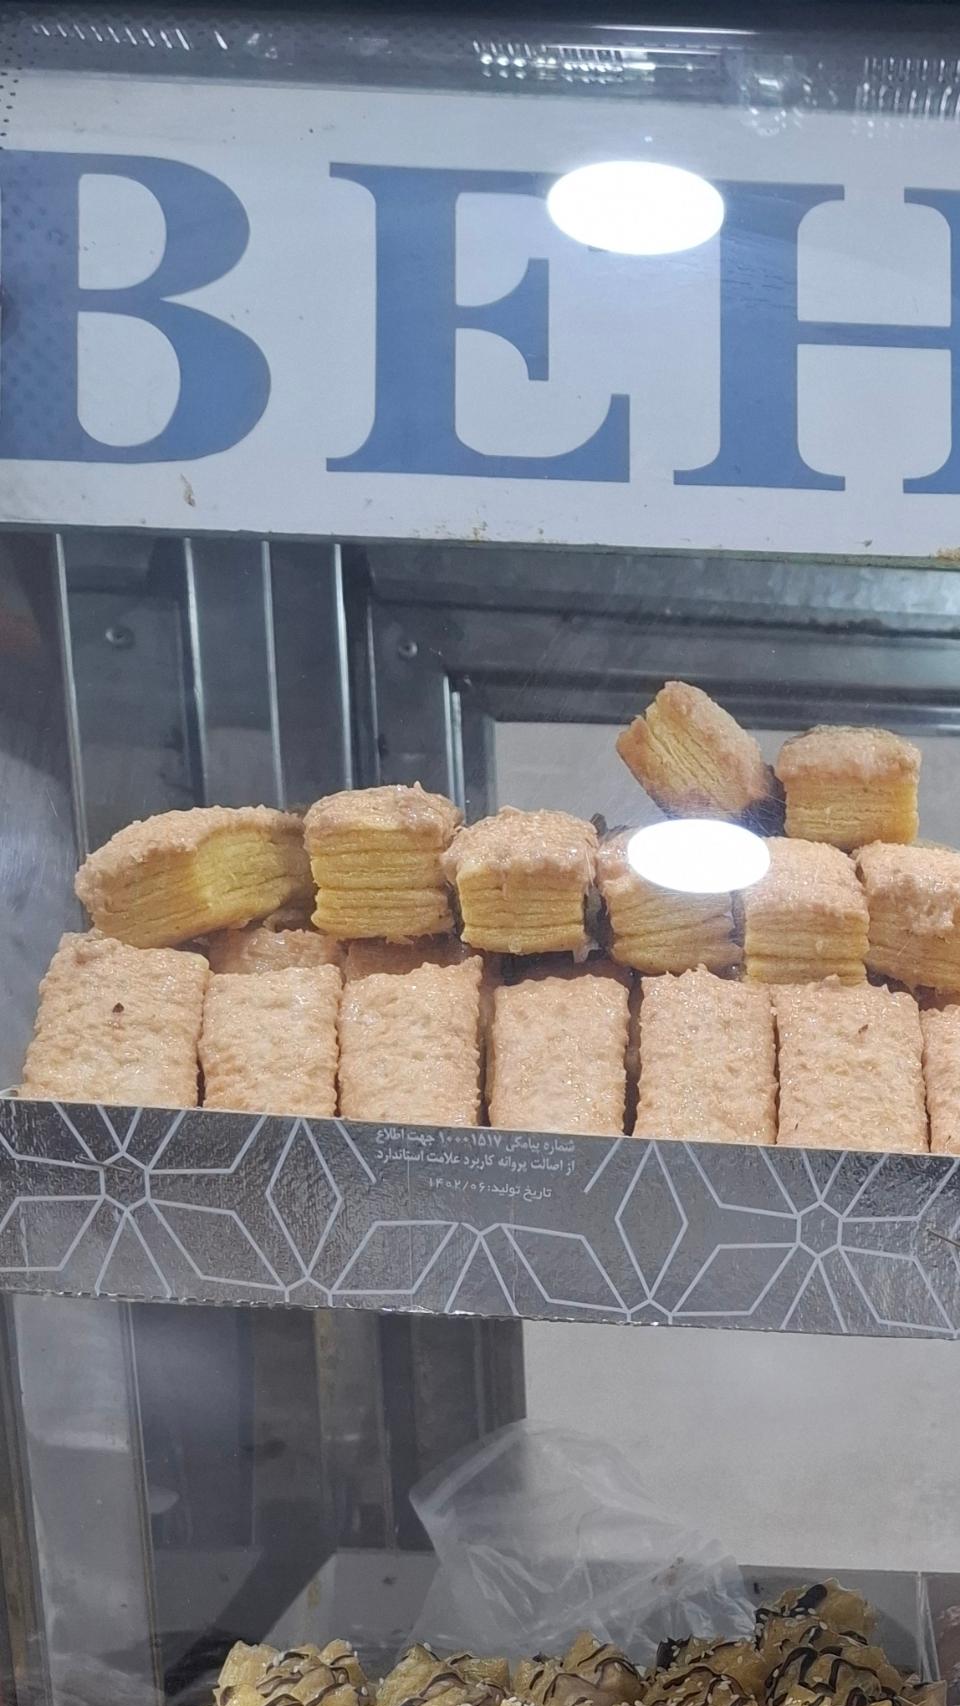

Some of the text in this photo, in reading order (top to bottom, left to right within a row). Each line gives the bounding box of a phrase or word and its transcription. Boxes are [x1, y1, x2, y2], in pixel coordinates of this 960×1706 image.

[375, 1127, 576, 1155] شماره پیامکی ۱۰۰۰۱۵۱۷ جهت اطلاع
[376, 1147, 576, 1176] از اصالت پروانه کاربرد علامت استاندارد
[523, 1184, 553, 1202] تاریخ
